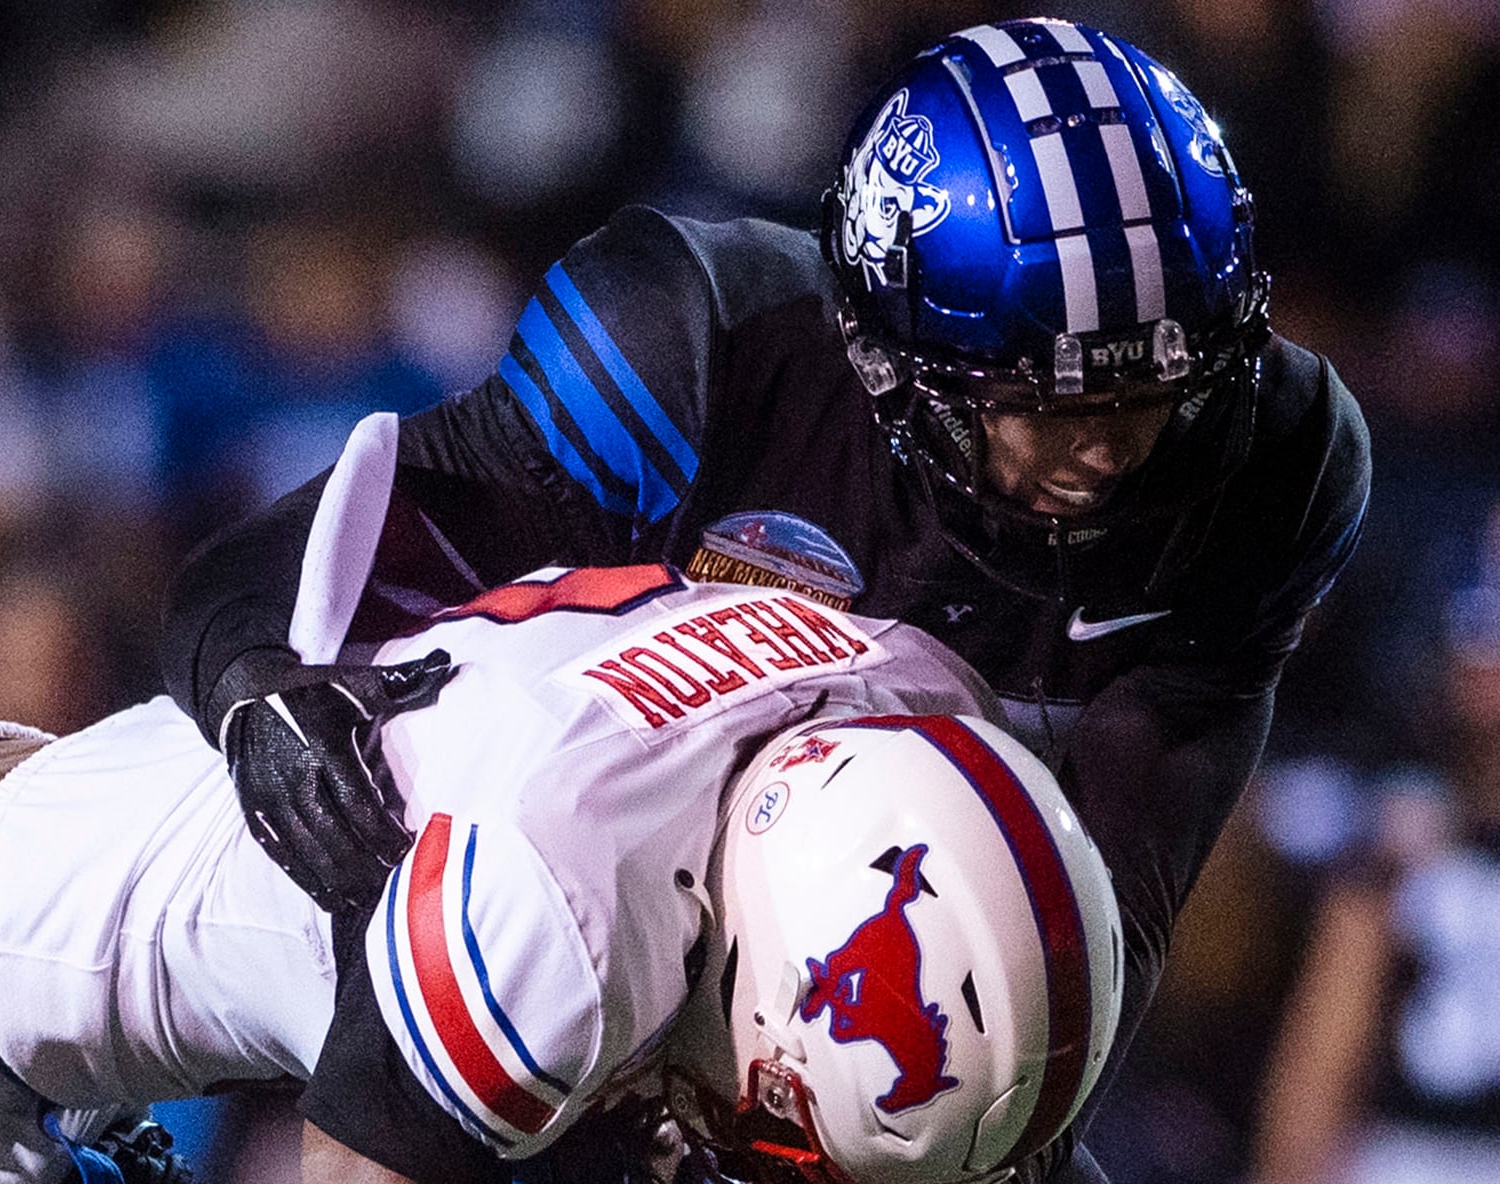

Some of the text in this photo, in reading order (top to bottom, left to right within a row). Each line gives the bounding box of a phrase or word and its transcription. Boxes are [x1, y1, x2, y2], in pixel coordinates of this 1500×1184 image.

[882, 135, 920, 176] BYU
[1090, 341, 1145, 367] BYU
[689, 548, 735, 578] NEW
[583, 597, 870, 728] WHEATON
